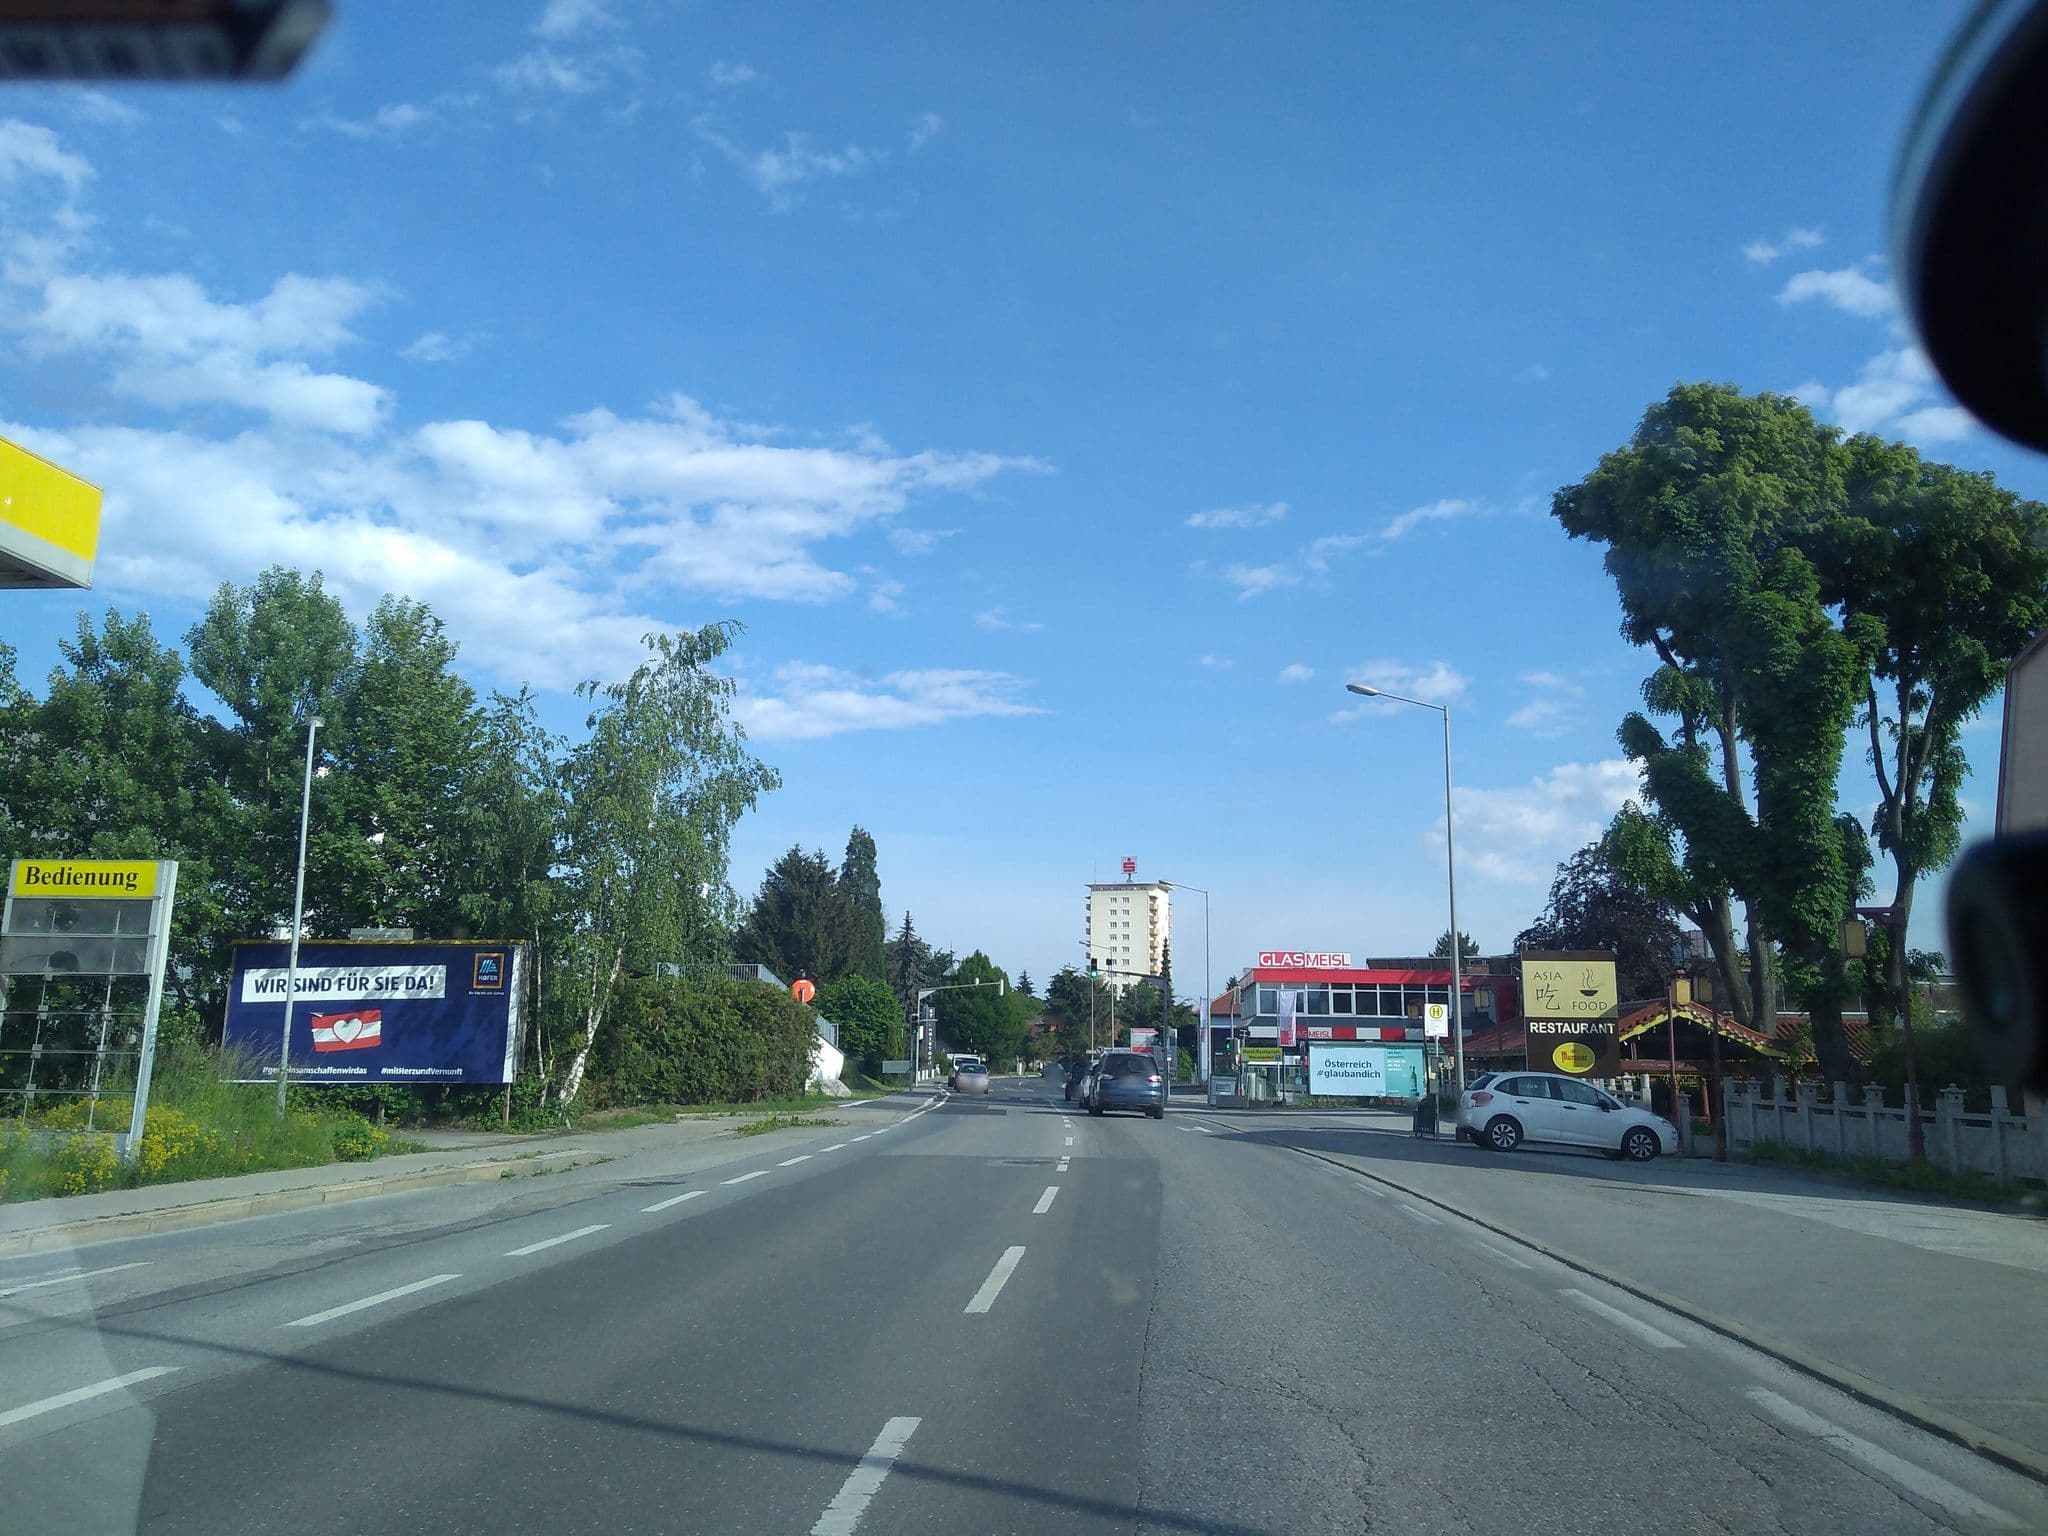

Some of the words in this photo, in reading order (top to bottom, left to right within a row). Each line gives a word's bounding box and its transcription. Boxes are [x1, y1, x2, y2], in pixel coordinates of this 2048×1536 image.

[25, 866, 139, 892] Bedienung
[1533, 971, 1563, 981] ASIA
[254, 978, 287, 994] WIR
[293, 976, 332, 993] SIND
[337, 973, 370, 992] FÜR
[374, 976, 400, 991] SIE
[405, 975, 435, 991] DA!
[1536, 983, 1561, 1011] 吃
[1572, 1001, 1608, 1011] FOOD
[1432, 1007, 1440, 1016] H
[1529, 1022, 1616, 1035] RESTAURANT
[1324, 1058, 1372, 1069] Österreich
[262, 1066, 368, 1076] #geeinsamschaffenwirdas
[1317, 1069, 1381, 1079] #glaubandich
